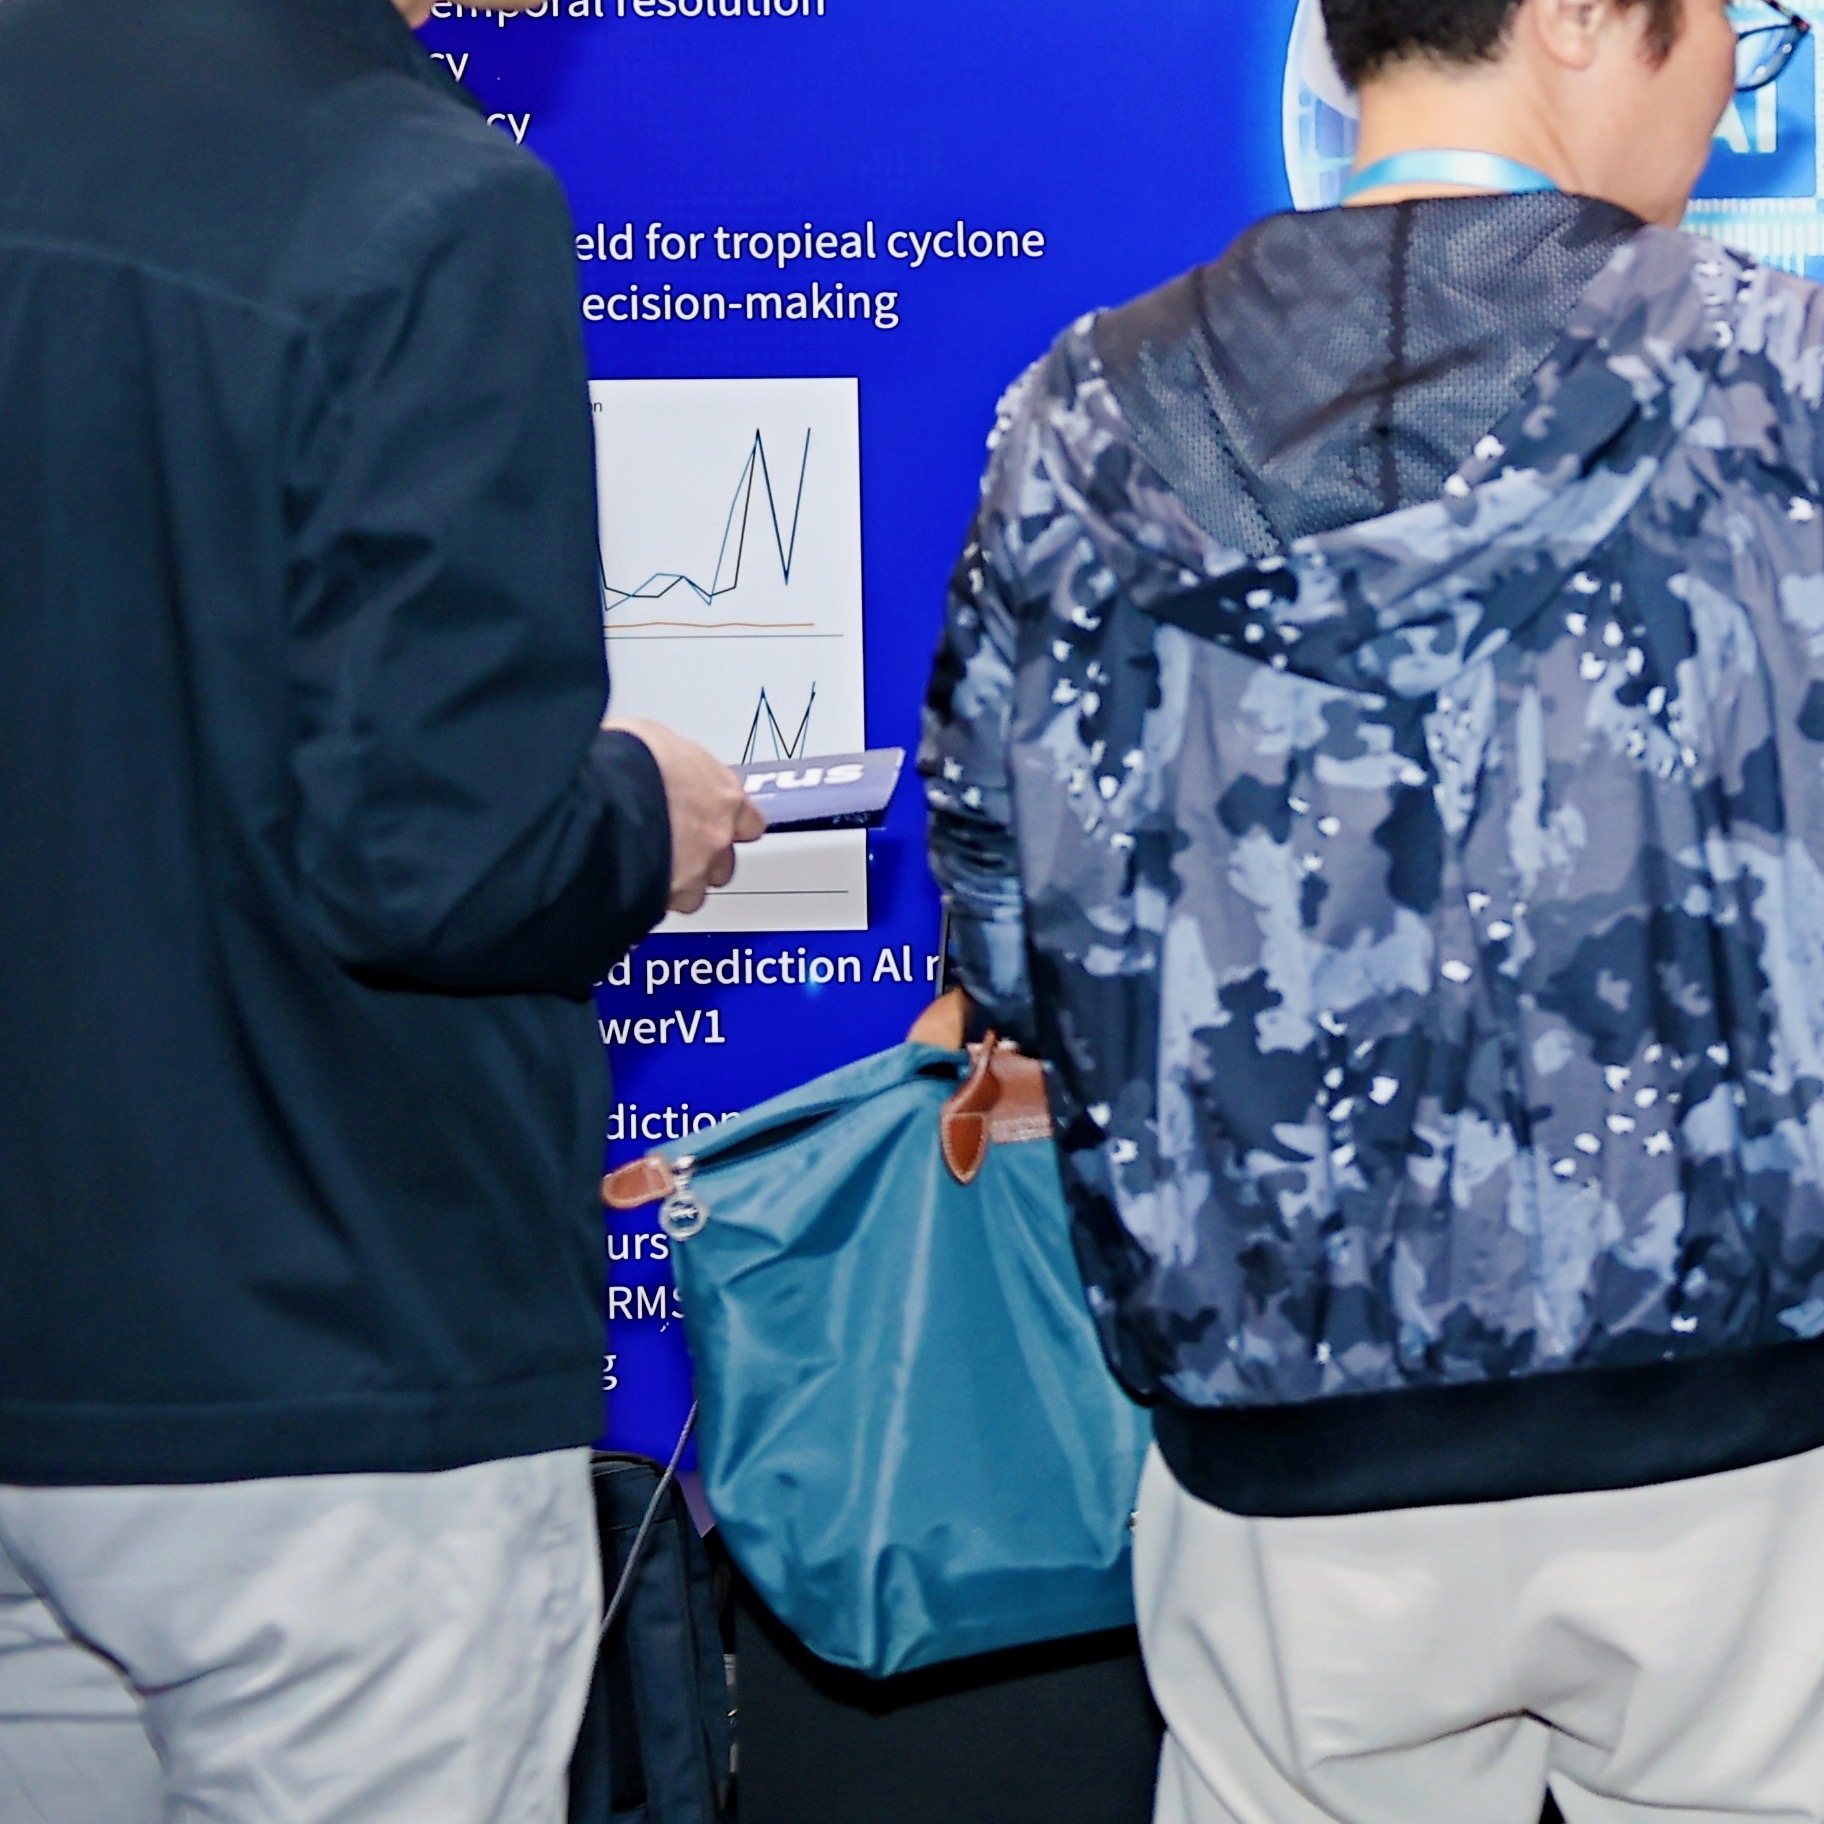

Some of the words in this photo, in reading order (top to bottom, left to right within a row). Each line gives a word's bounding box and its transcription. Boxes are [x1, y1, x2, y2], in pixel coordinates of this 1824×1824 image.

[575, 222, 633, 261] eld
[645, 222, 705, 260] for
[887, 220, 1046, 269] cyclone
[582, 282, 900, 330] ecision-making
[646, 947, 861, 995] prediction
[607, 1232, 670, 1260] urs
